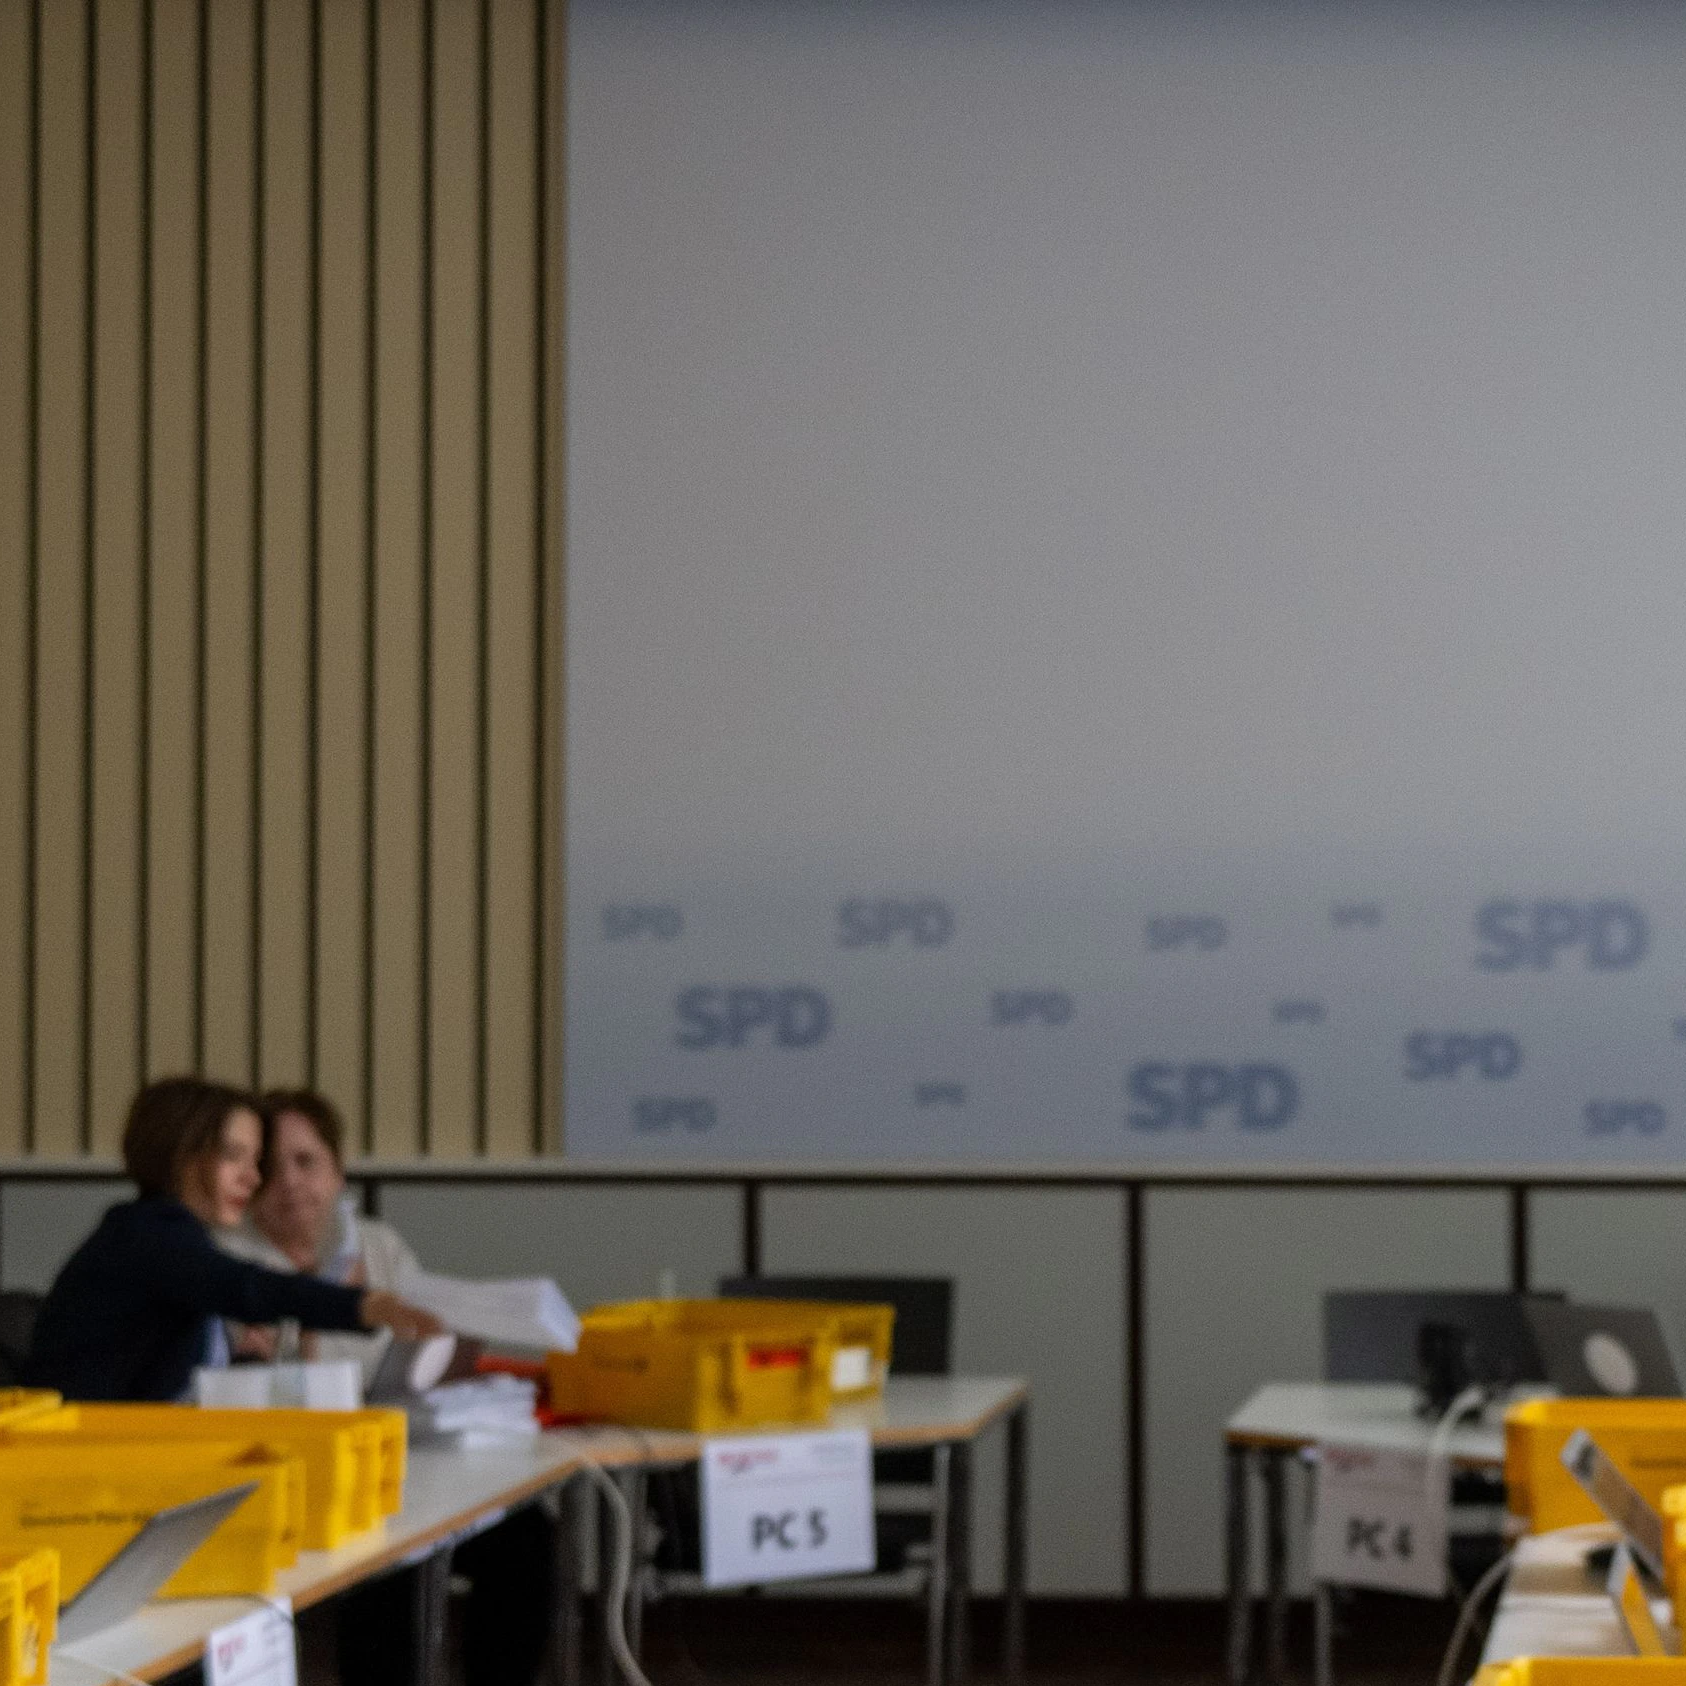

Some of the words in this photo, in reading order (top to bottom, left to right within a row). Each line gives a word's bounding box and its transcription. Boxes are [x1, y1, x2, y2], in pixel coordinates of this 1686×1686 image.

[603, 903, 684, 942] SPD
[838, 898, 955, 950] SPD
[1144, 914, 1227, 950] SPD
[1476, 900, 1648, 972] SPD
[677, 985, 832, 1050] SPD
[992, 991, 1074, 1027] SPD
[1406, 1030, 1521, 1081] SPD
[632, 1096, 716, 1133] SPD
[1128, 1059, 1298, 1133] SPD
[1584, 1102, 1666, 1137] SPD
[751, 1512, 796, 1551] PC
[808, 1507, 829, 1549] 5
